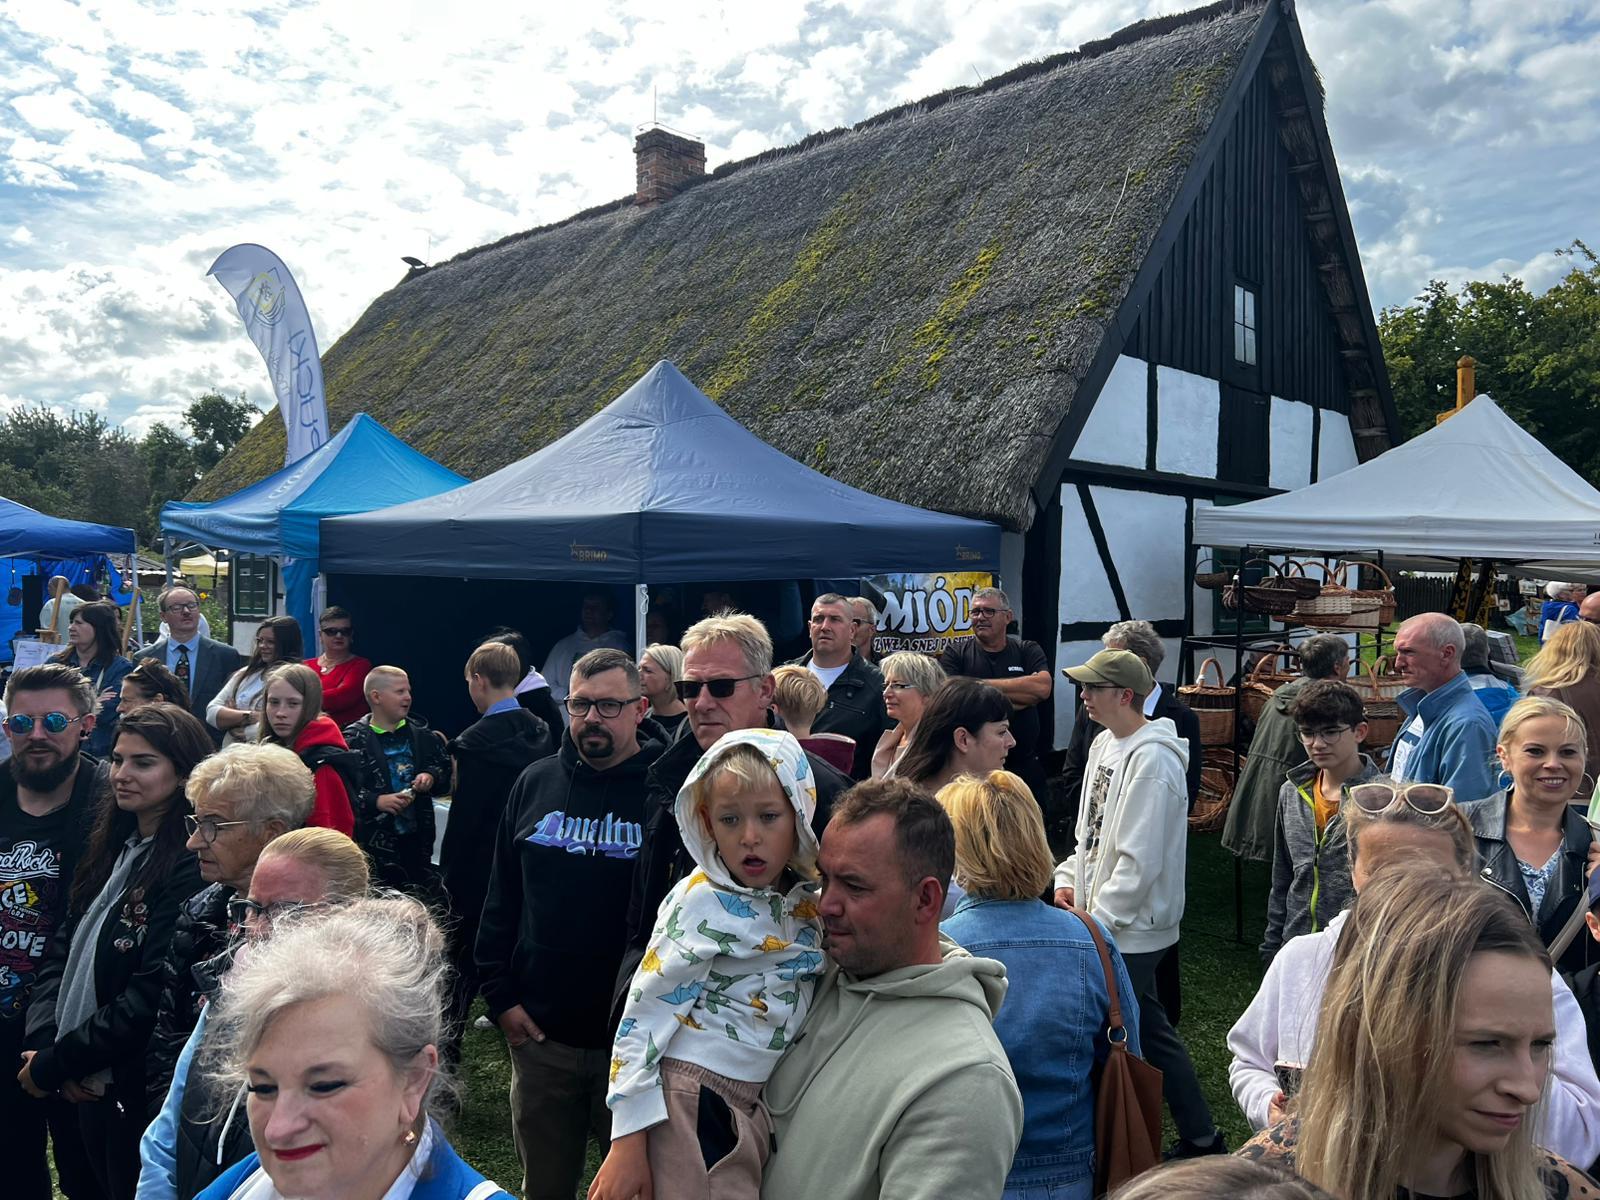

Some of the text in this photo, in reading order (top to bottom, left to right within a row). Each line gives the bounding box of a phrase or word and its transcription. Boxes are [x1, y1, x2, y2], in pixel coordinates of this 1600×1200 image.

[876, 577, 974, 634] MIÓD
[525, 810, 642, 857] Loyalty
[0, 926, 46, 957] OVE
